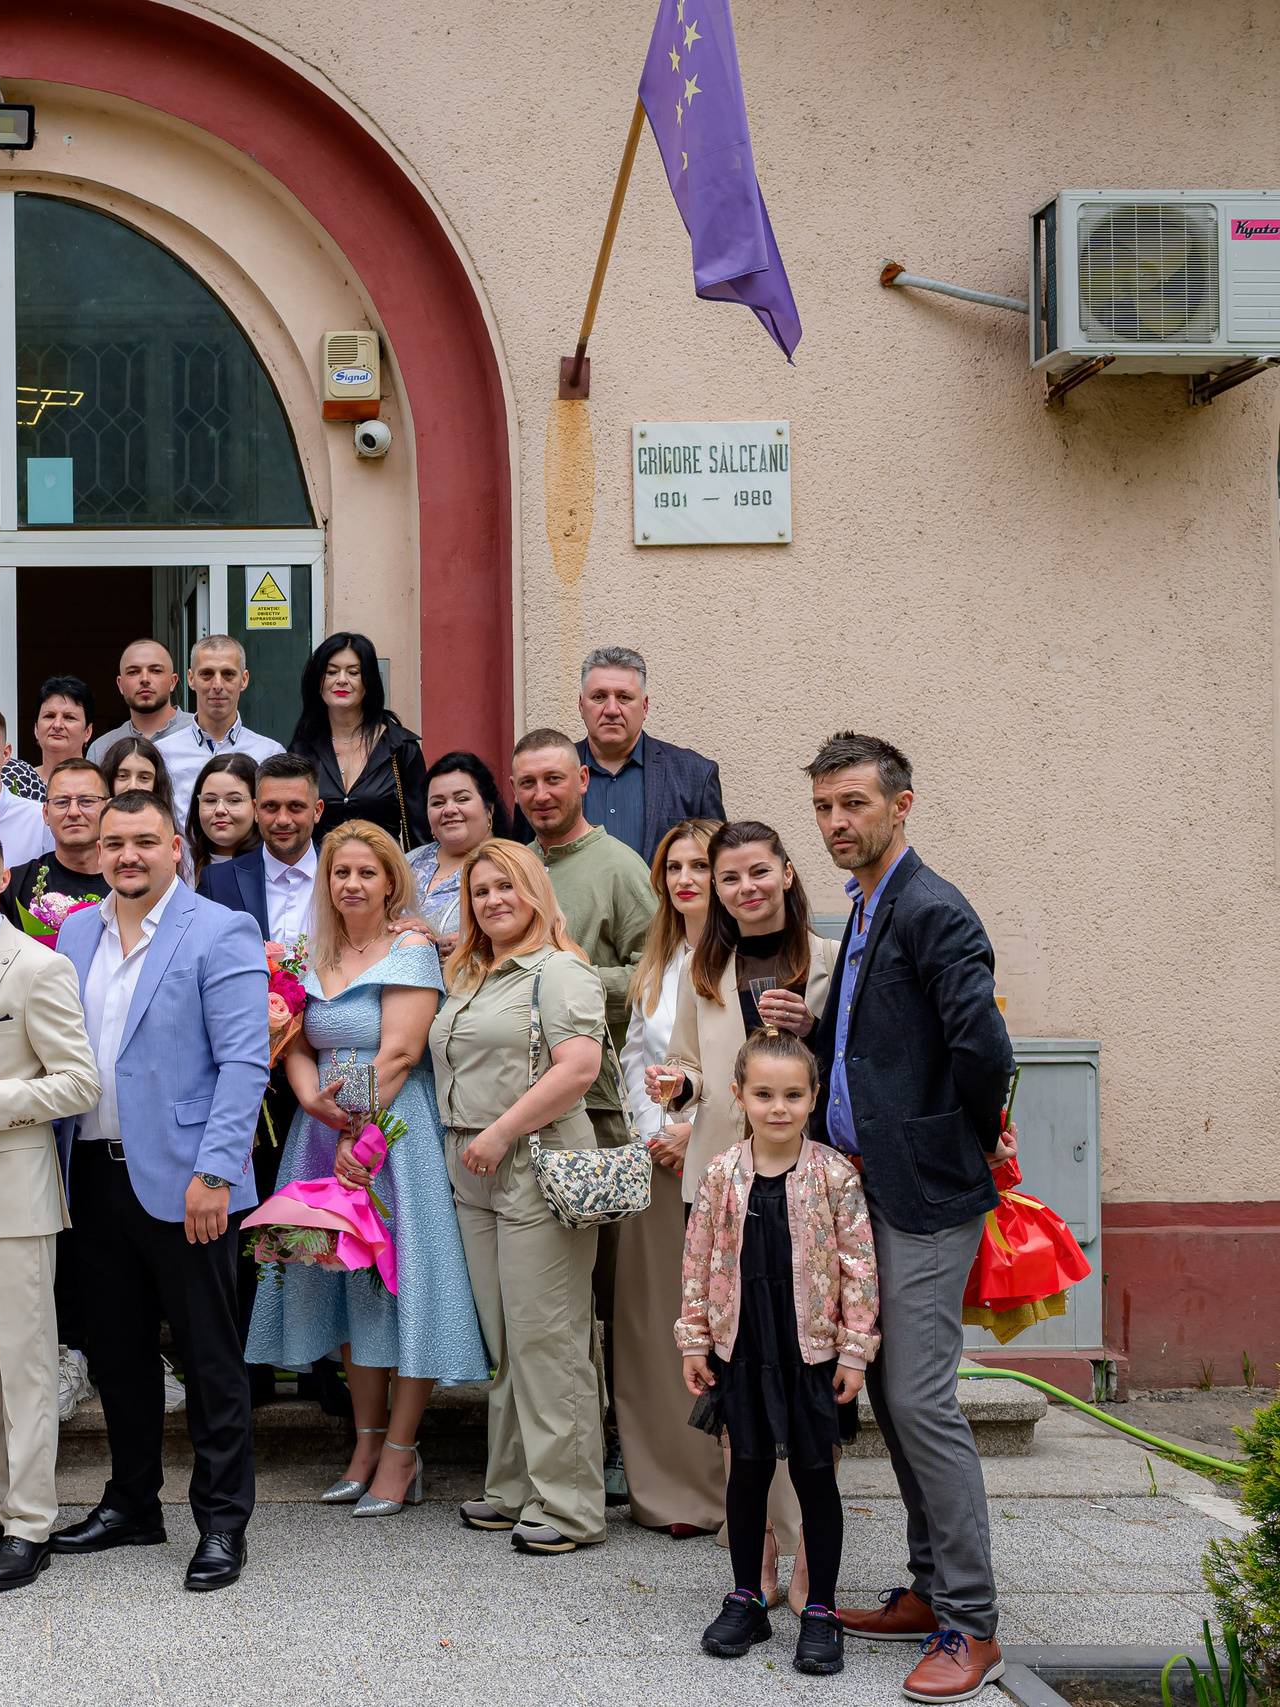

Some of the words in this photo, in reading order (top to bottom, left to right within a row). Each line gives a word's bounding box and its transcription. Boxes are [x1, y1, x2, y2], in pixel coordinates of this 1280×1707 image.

[336, 372, 368, 383] Signal
[654, 492, 688, 508] 1901
[734, 490, 772, 506] 1980
